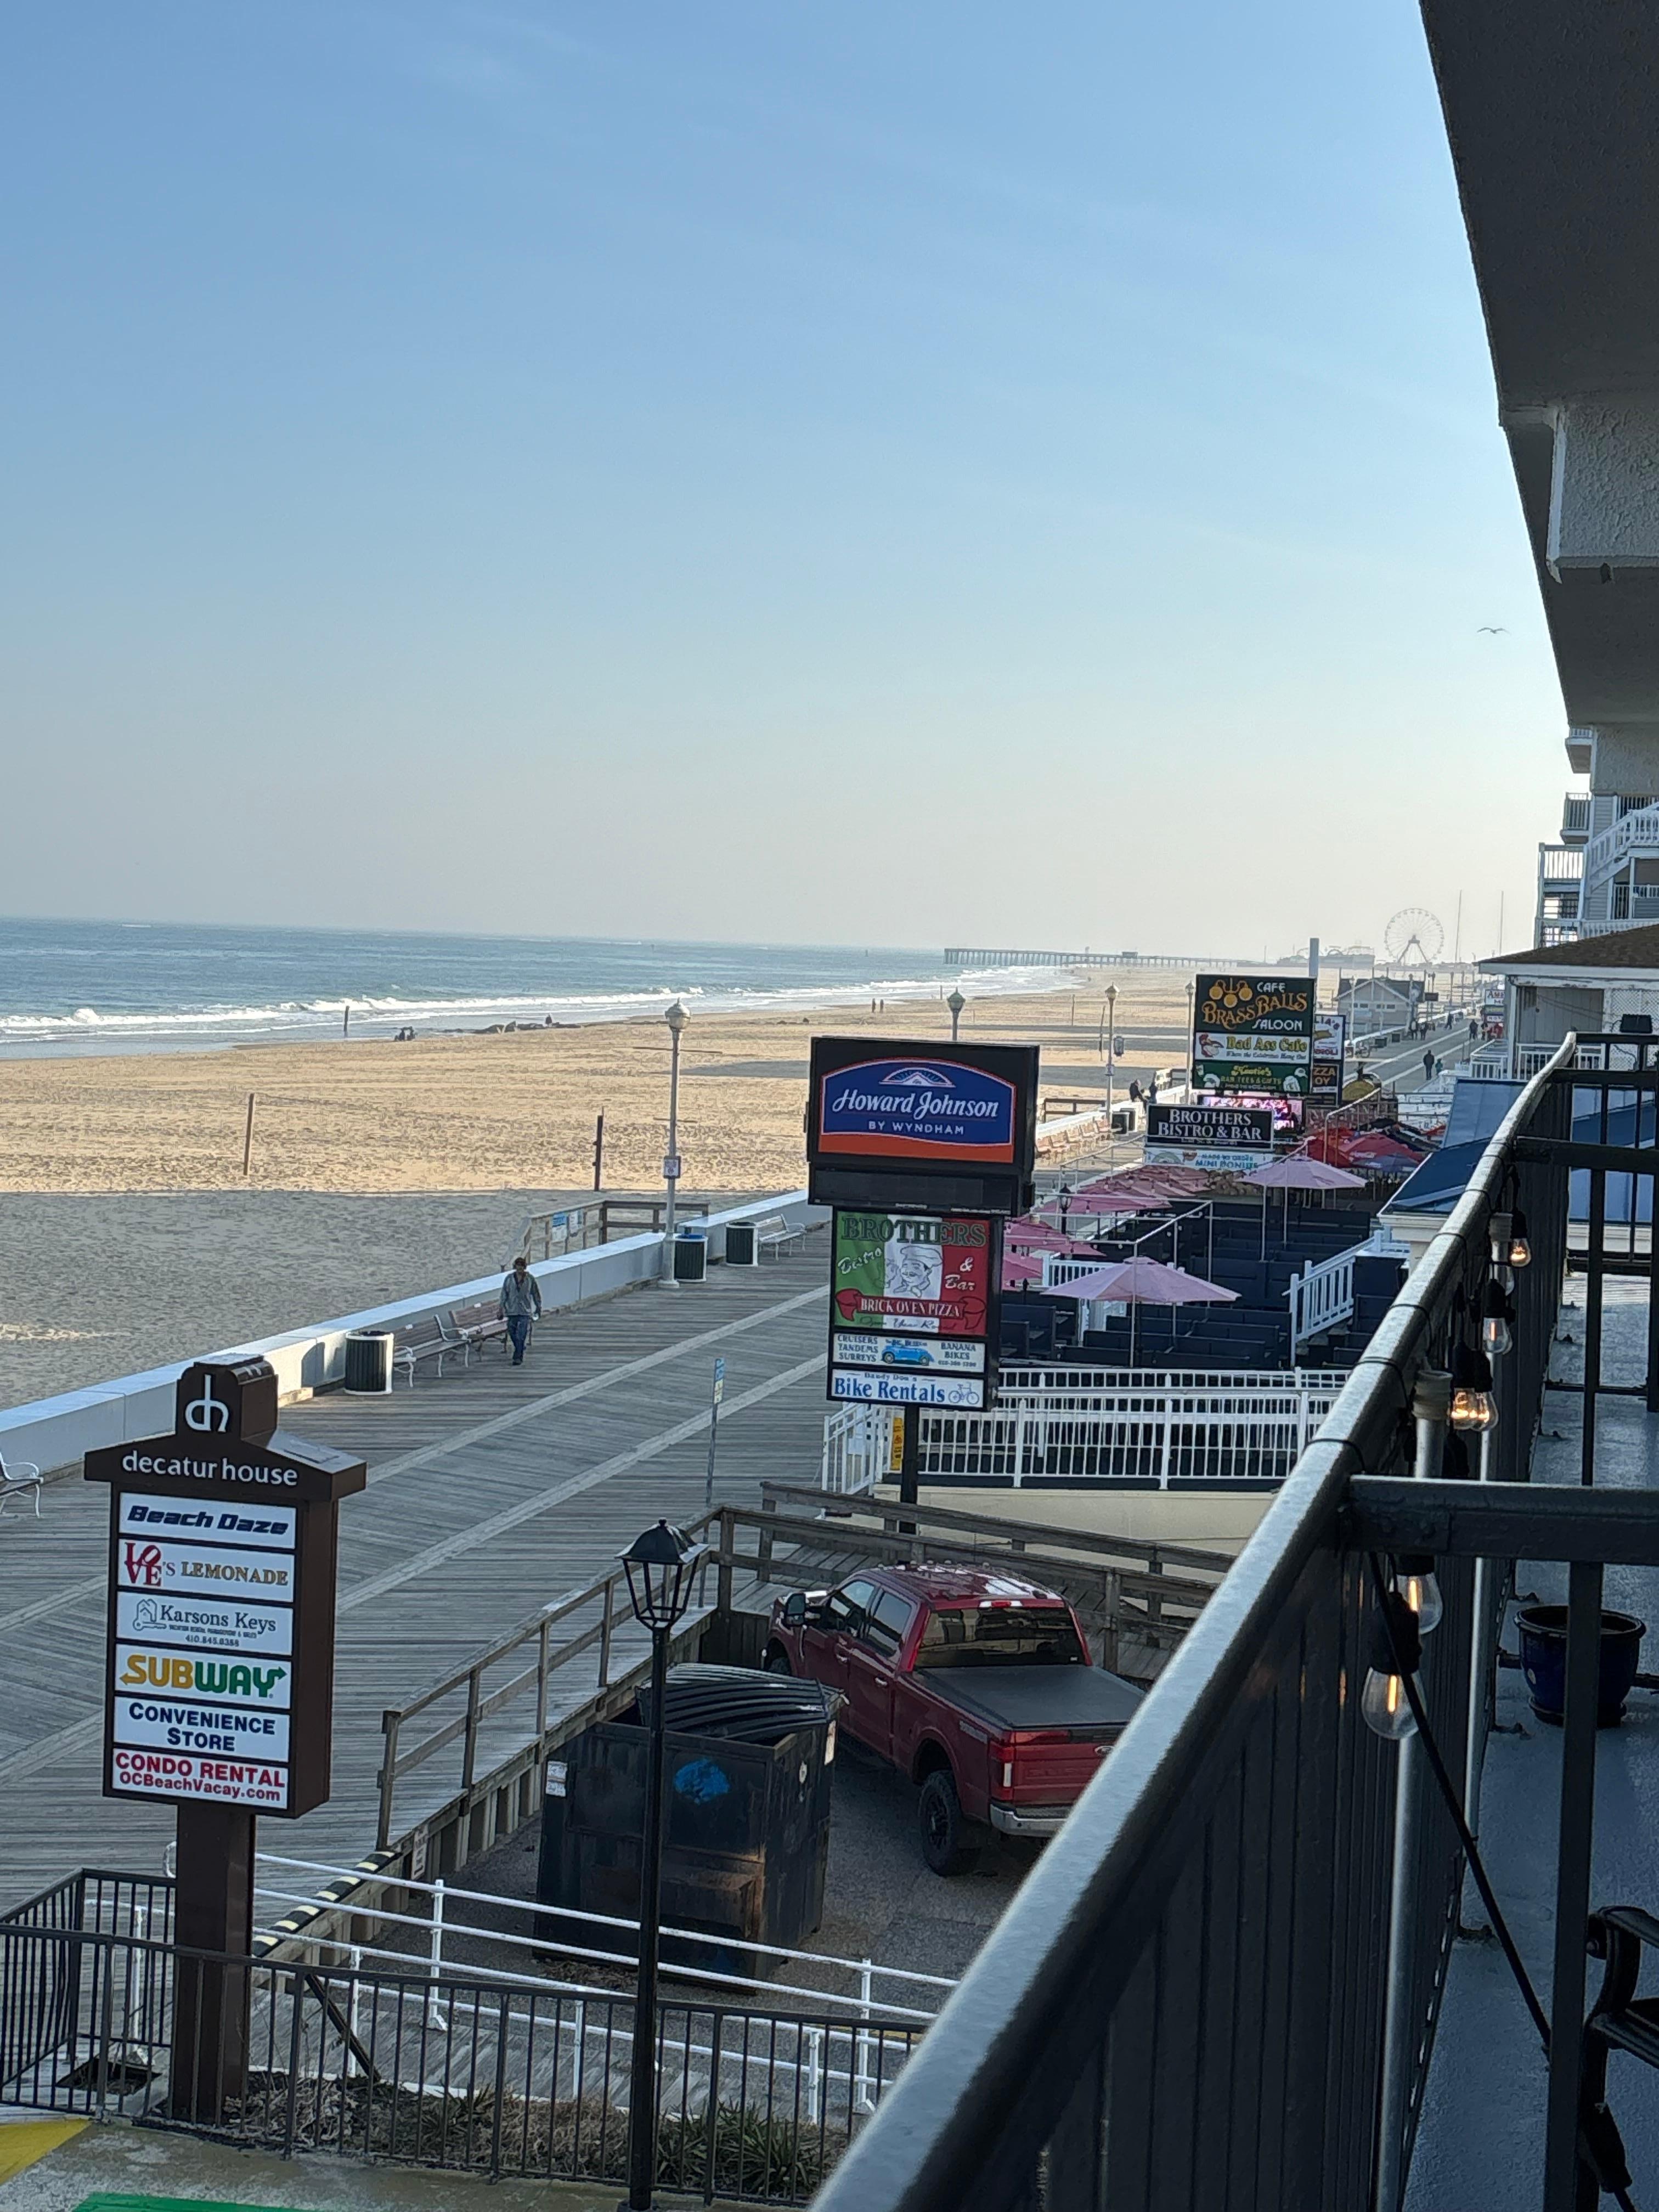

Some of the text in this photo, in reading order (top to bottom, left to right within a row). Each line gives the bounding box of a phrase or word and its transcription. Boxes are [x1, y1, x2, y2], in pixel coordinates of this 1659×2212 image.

[1256, 981, 1286, 992] CAFE
[1201, 992, 1307, 1030] BRASS BALLS
[1252, 1019, 1302, 1031] SALOON
[1226, 1036, 1252, 1050] Bad
[1253, 1036, 1277, 1052] Ass
[1279, 1037, 1307, 1052] Cafe
[1313, 1067, 1335, 1076] ZZA
[1314, 1076, 1330, 1086] OY
[832, 1088, 999, 1120] Howard Johnson
[1169, 1108, 1252, 1125] BROTHERS
[868, 1121, 964, 1135] BY WYNDHAM
[1158, 1121, 1262, 1139] BISTRO & BAR
[842, 1216, 987, 1247] BROTHERS
[960, 1257, 974, 1272] &
[944, 1274, 975, 1291] Bar
[860, 1297, 960, 1318] BRICK OVEN PIZZA
[838, 1334, 878, 1345] CRUISERS
[838, 1343, 878, 1353] TANDEMS
[941, 1342, 976, 1351] BANANA
[838, 1352, 877, 1362] SURREYS
[944, 1351, 970, 1360] BIKES
[834, 1377, 945, 1403] Bike Rentals
[122, 1450, 298, 1486] decatur house
[127, 1505, 289, 1535] Beach Daze
[181, 1561, 289, 1586] LEMONADE
[160, 1605, 229, 1627] Karsons
[235, 1612, 276, 1635] Keys
[119, 1654, 287, 1698] SUBWAY
[129, 1702, 275, 1735] CONVENIENCE
[167, 1728, 235, 1751] STORE
[115, 1752, 285, 1787] CONDO RENTAL
[120, 1771, 280, 1801] OCBeachVacay.com
